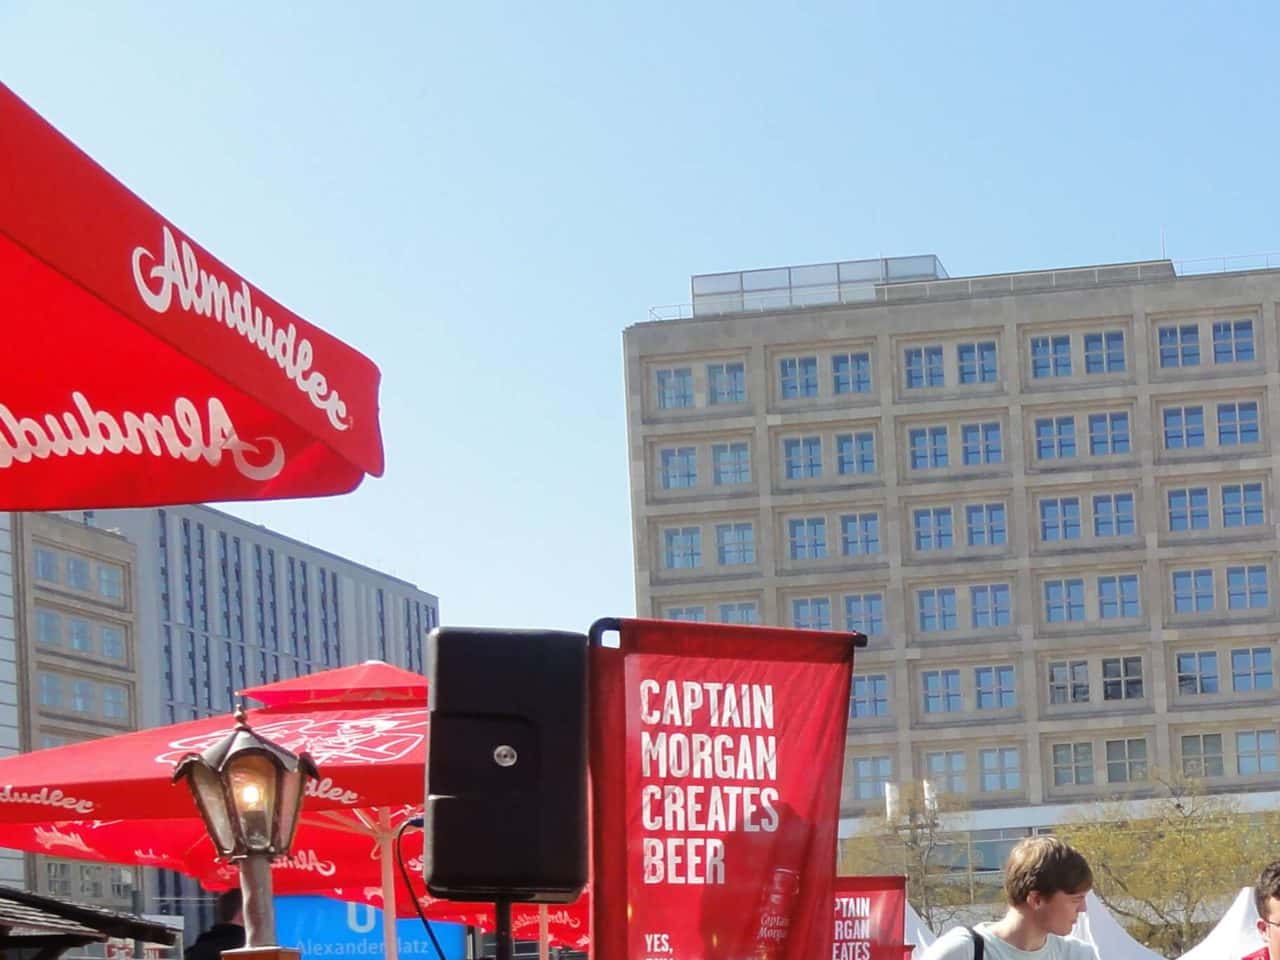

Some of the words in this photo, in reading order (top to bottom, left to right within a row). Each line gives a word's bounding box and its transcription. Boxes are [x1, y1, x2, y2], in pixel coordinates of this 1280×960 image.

[131, 226, 349, 431] Almdudler
[640, 679, 775, 729] CAPTAIN
[641, 733, 778, 781] MORGAN
[0, 784, 95, 814] dudler
[641, 785, 780, 832] CREATES
[643, 838, 726, 885] BEER
[347, 901, 376, 933] U
[834, 920, 870, 940] RGAN
[297, 937, 429, 957] Alexanderlatz
[645, 933, 673, 954] YES,
